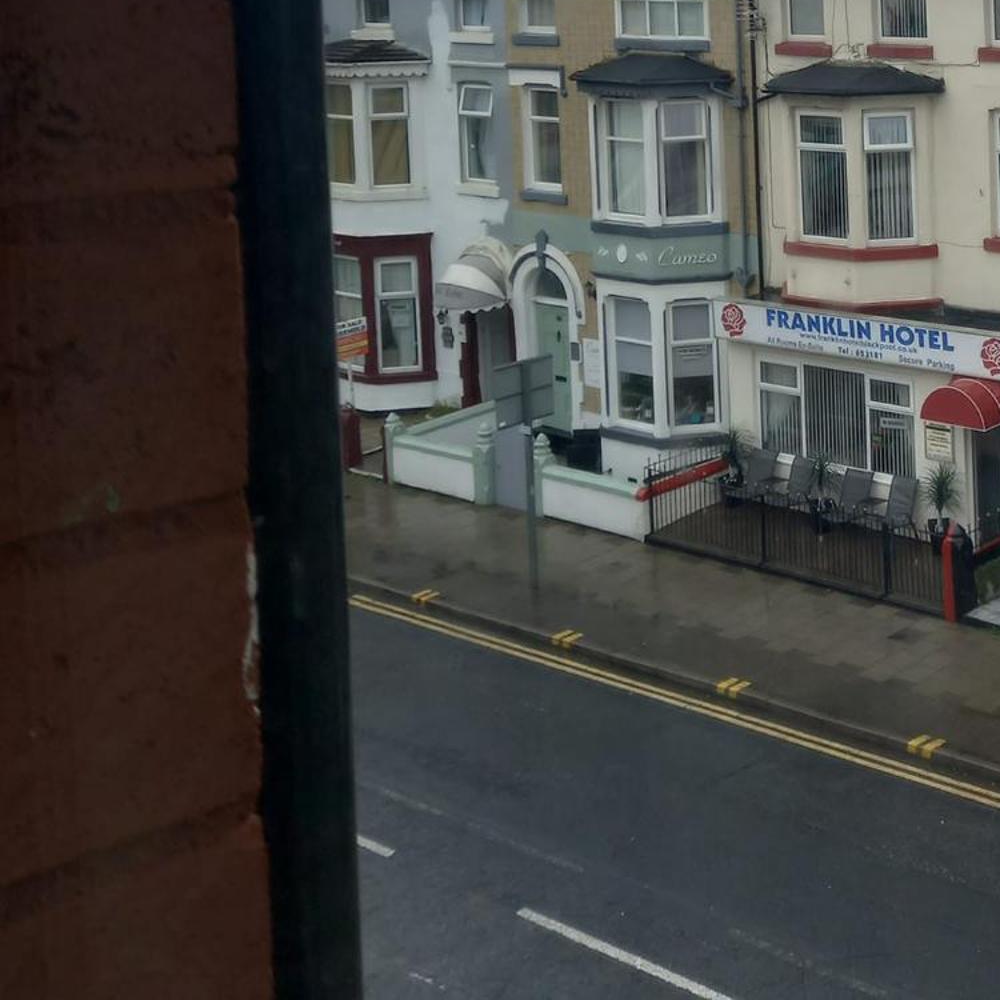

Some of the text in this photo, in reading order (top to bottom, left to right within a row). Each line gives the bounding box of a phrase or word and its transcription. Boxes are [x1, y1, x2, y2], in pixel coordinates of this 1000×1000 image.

[766, 308, 955, 352] FRANKLIN HOTEL
[927, 358, 955, 372] Parking
